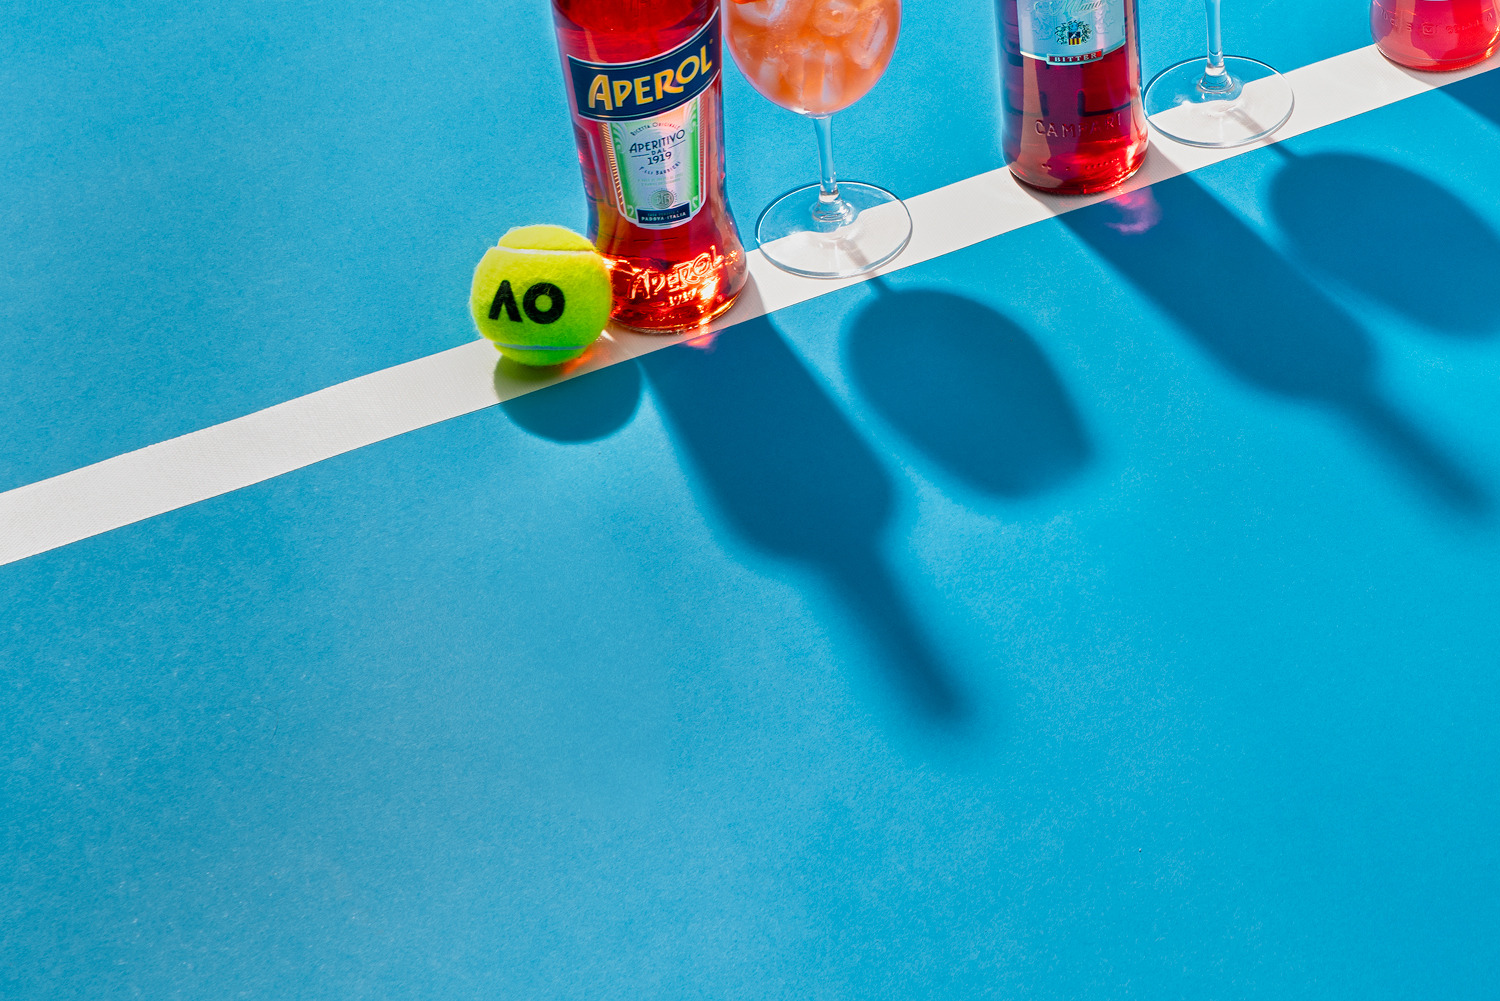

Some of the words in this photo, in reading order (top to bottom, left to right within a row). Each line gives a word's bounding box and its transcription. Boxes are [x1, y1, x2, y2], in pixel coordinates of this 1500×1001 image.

[1054, 52, 1098, 62] BITTER
[588, 45, 713, 111] APEROL
[630, 124, 651, 137] RICETTA
[652, 121, 681, 130] ORIGINALE
[629, 129, 686, 153] APERITIVO
[647, 151, 672, 165] 1919
[651, 147, 667, 156] DAL
